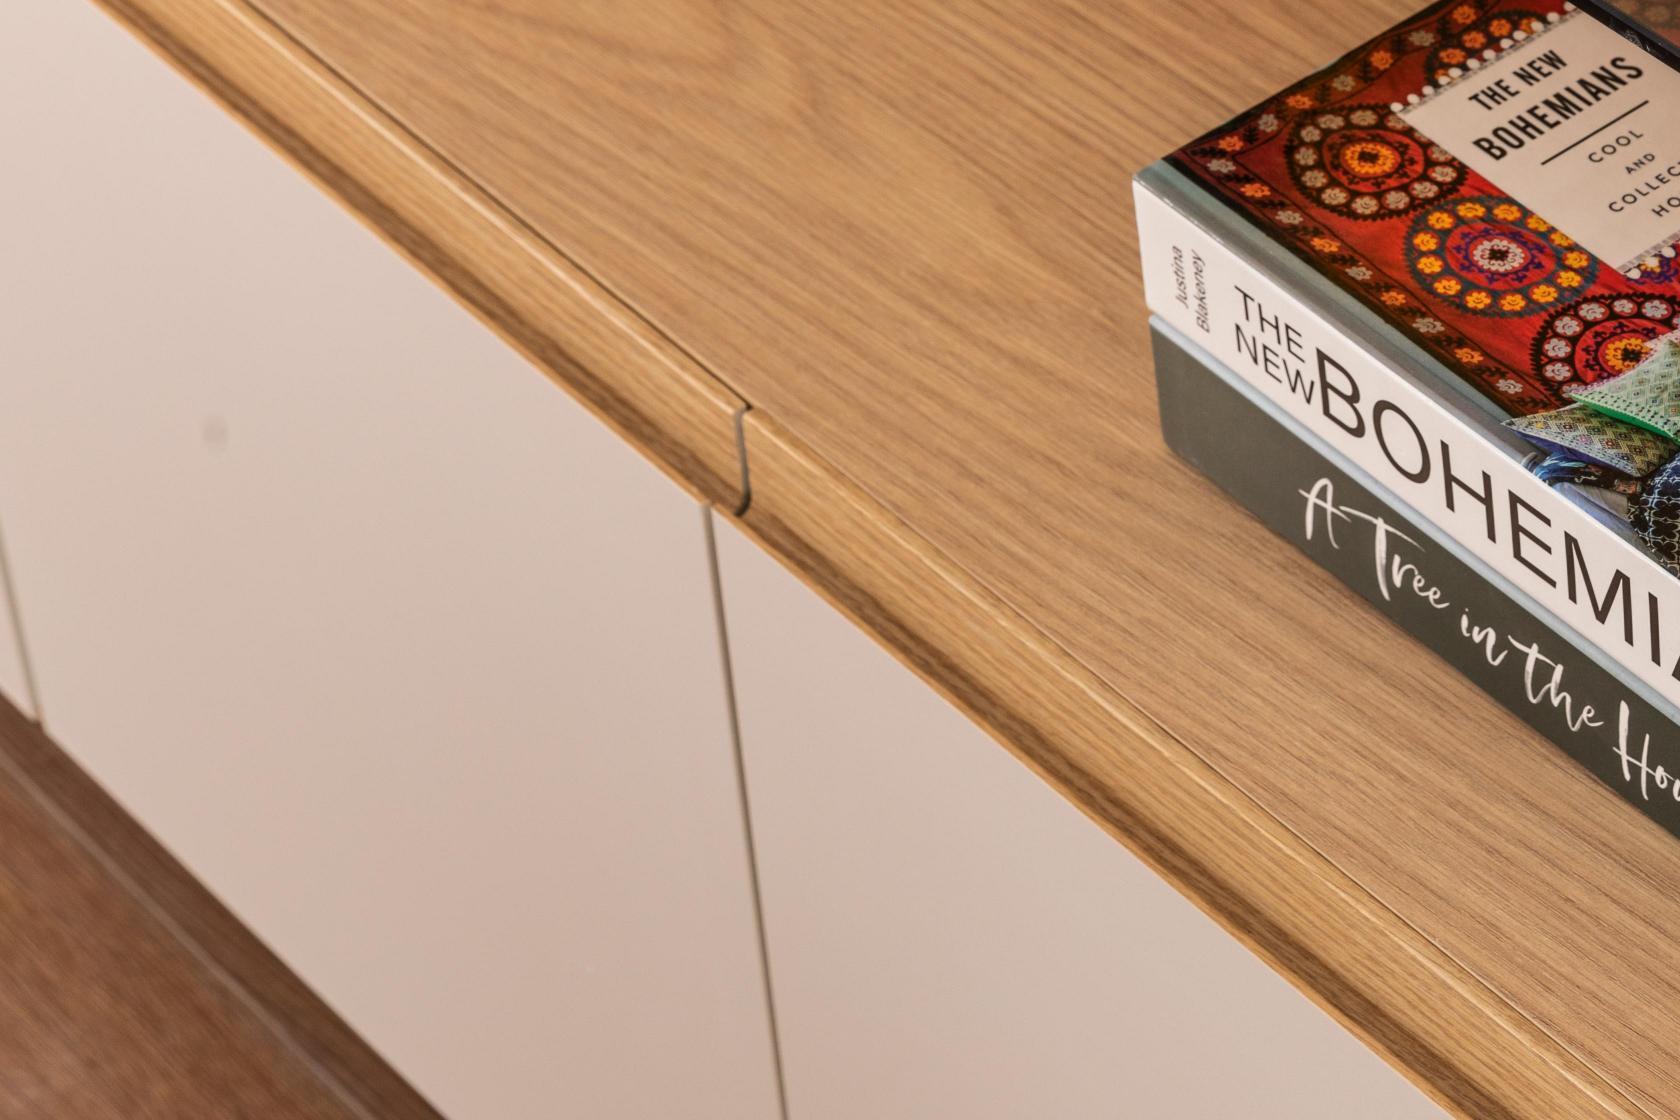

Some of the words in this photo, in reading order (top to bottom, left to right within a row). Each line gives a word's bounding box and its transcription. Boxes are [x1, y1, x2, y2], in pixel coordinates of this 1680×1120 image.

[1468, 78, 1521, 111] THE
[1512, 49, 1568, 87] NEW
[1472, 56, 1644, 161] BOHEMIANS
[1588, 129, 1644, 164] COOL
[1624, 152, 1656, 175] AND
[1171, 245, 1189, 309] Justina
[1190, 249, 1211, 333] Blakeney
[1234, 285, 1306, 363] THE
[1235, 322, 1315, 405] NEW
[1298, 477, 1352, 549] A
[1339, 505, 1451, 610] Tree
[1460, 607, 1508, 666] in
[1507, 634, 1604, 732] the
